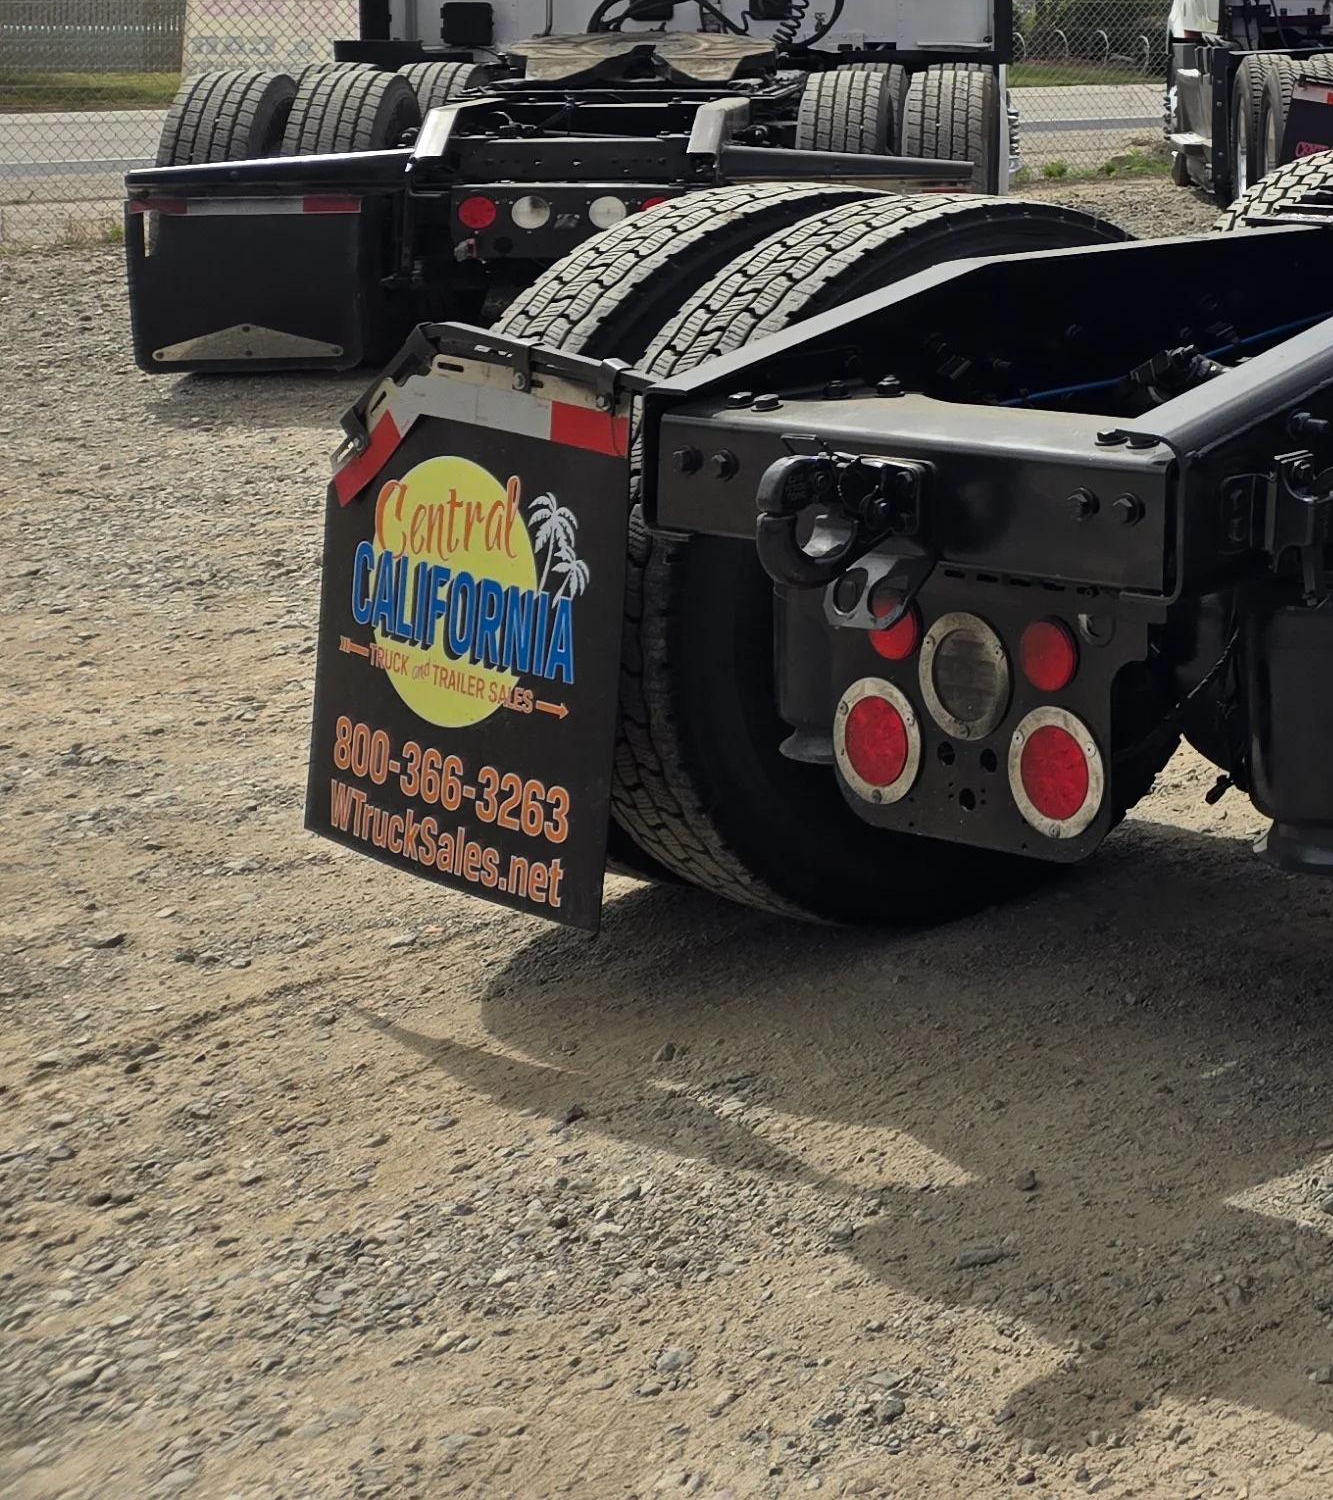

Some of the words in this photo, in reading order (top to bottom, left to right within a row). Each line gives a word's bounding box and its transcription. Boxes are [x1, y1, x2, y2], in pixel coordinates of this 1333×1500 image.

[375, 474, 521, 564] Central
[350, 539, 575, 685] CALIFORNIA
[369, 643, 409, 676] TRUCK
[411, 656, 431, 680] and
[432, 664, 485, 699] TRAILER
[487, 681, 534, 714] SALES
[329, 777, 564, 909] WTruckSales.net
[332, 716, 571, 845] 800-366-3263
